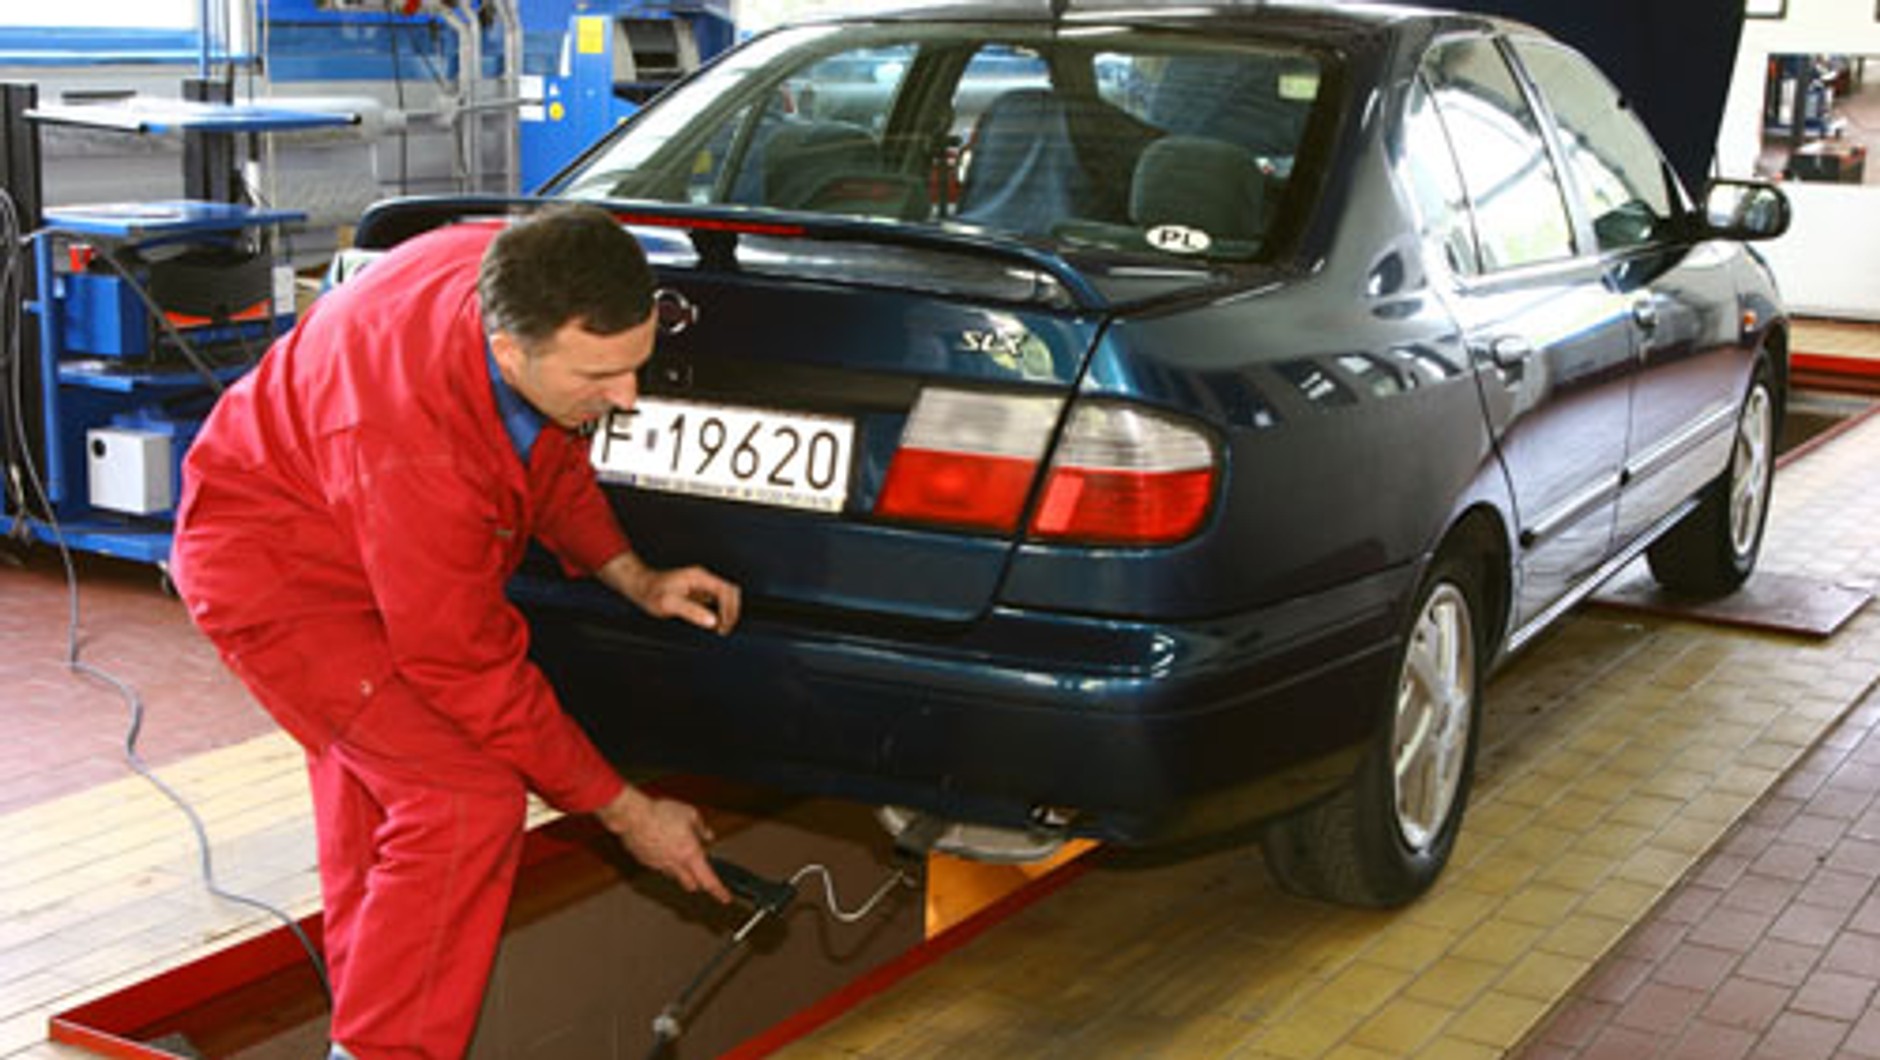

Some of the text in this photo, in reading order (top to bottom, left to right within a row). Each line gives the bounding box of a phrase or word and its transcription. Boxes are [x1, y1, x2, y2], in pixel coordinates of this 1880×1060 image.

[1160, 229, 1199, 249] PL
[582, 406, 839, 490] F 19620
